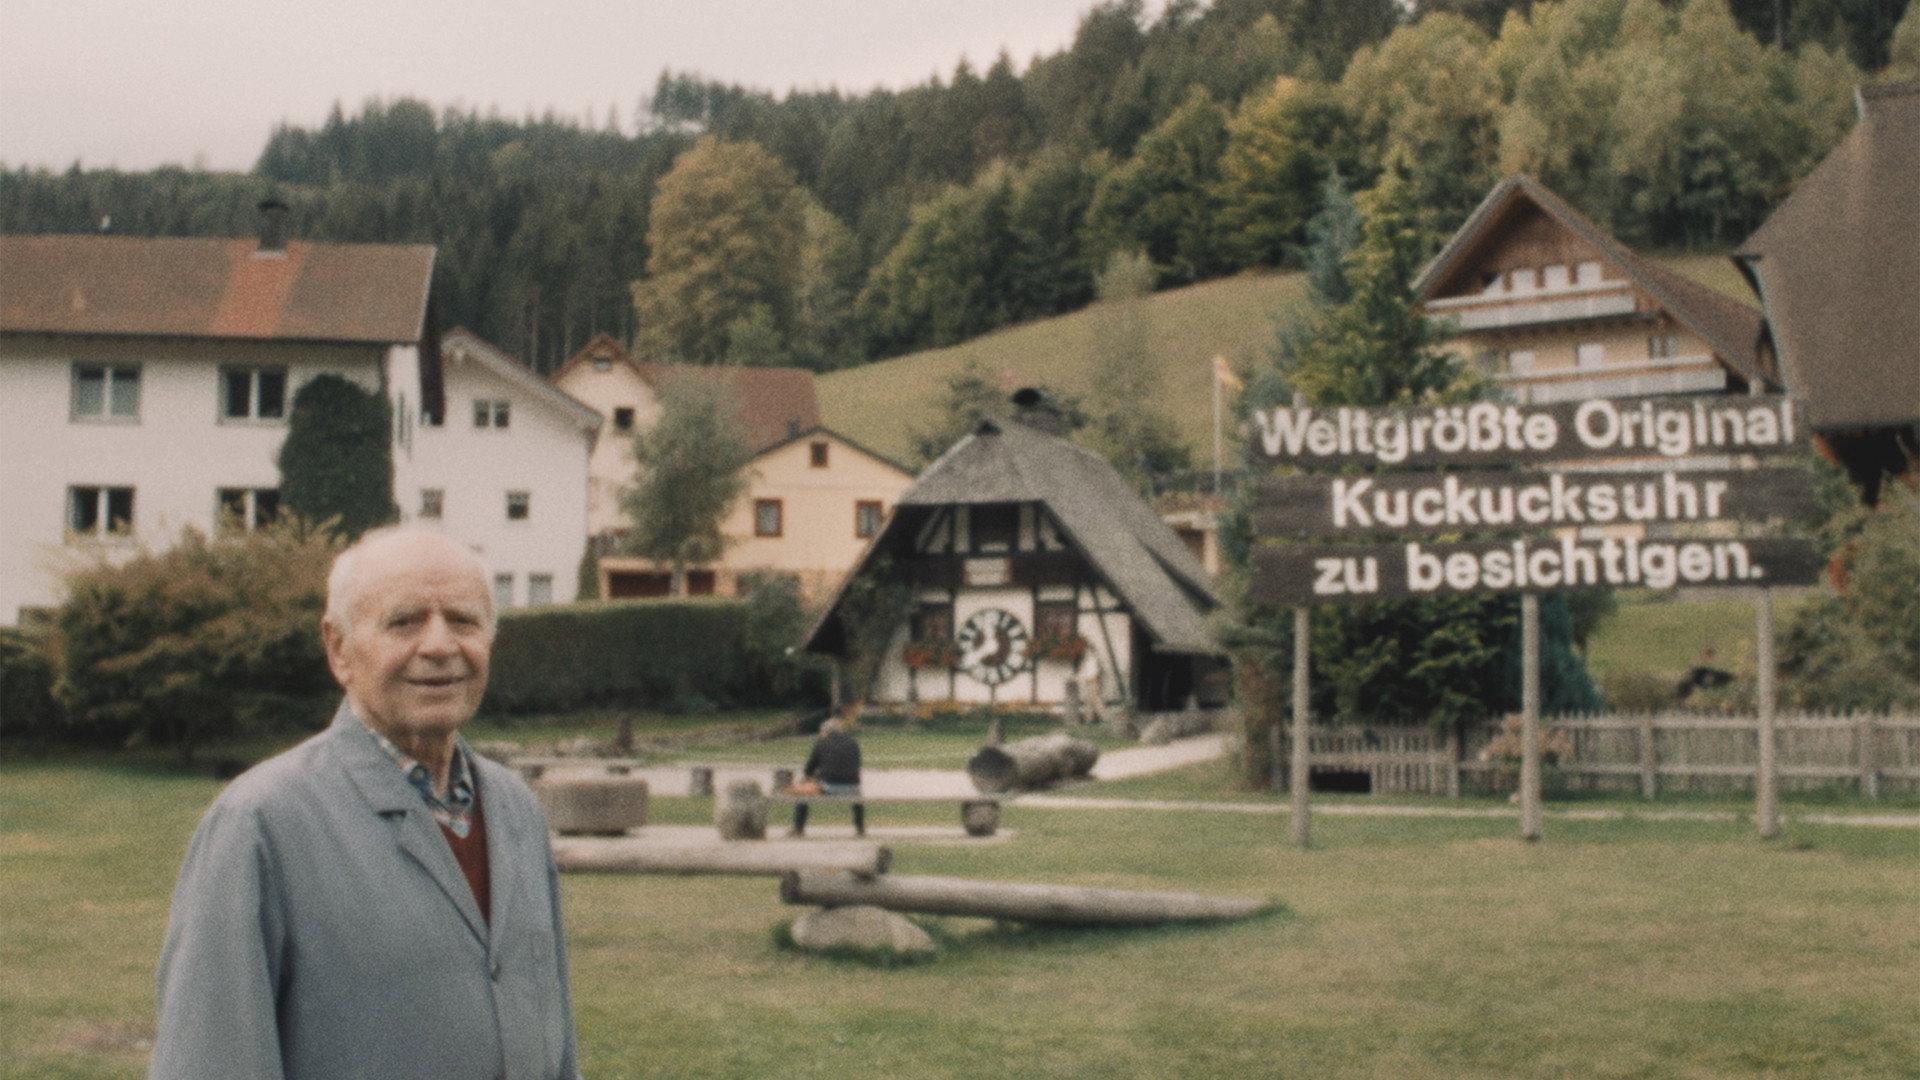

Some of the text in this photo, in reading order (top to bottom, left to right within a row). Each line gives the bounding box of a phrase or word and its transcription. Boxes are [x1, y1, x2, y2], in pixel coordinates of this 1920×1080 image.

[1256, 401, 1793, 461] Weltgrößte Original
[1332, 473, 1727, 527] Kuckucksuhr
[1314, 538, 1763, 594] zu besichtigen.
